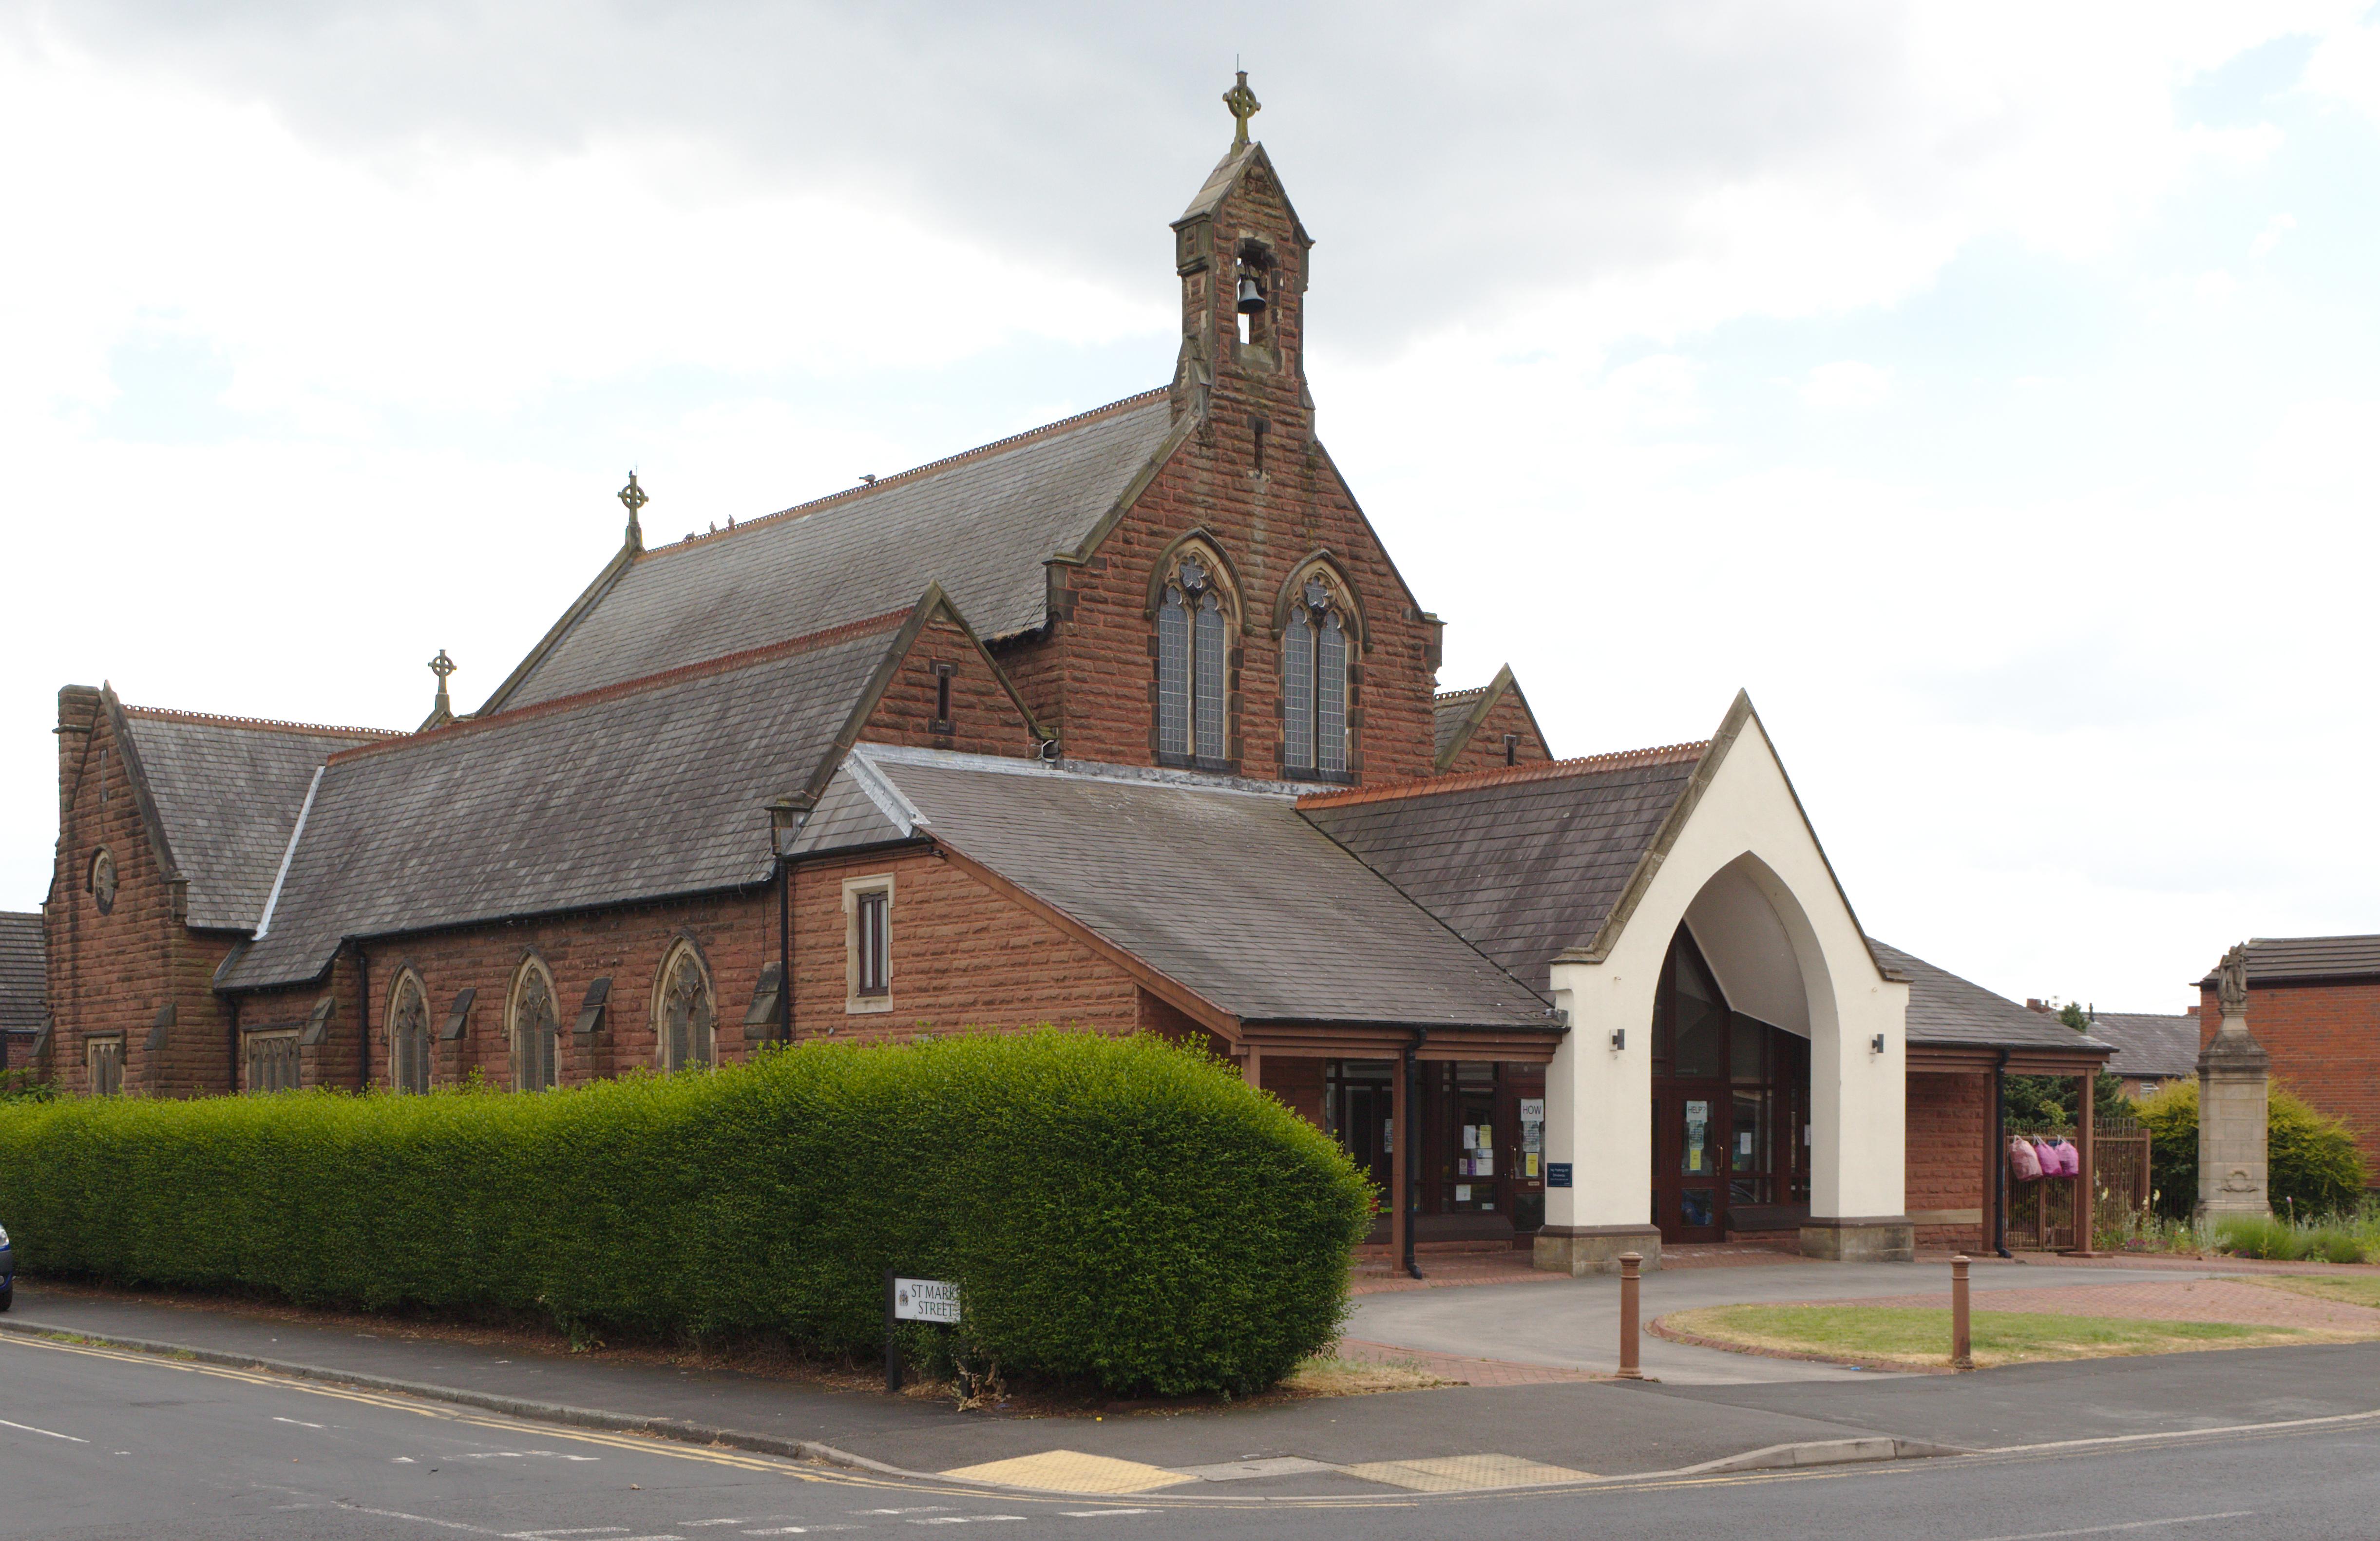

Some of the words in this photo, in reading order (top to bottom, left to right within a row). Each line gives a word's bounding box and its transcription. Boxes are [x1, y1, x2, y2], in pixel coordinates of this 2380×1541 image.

[1523, 1105, 1541, 1114] HOW
[912, 1284, 923, 1298] ST
[918, 1301, 953, 1316] STREET
